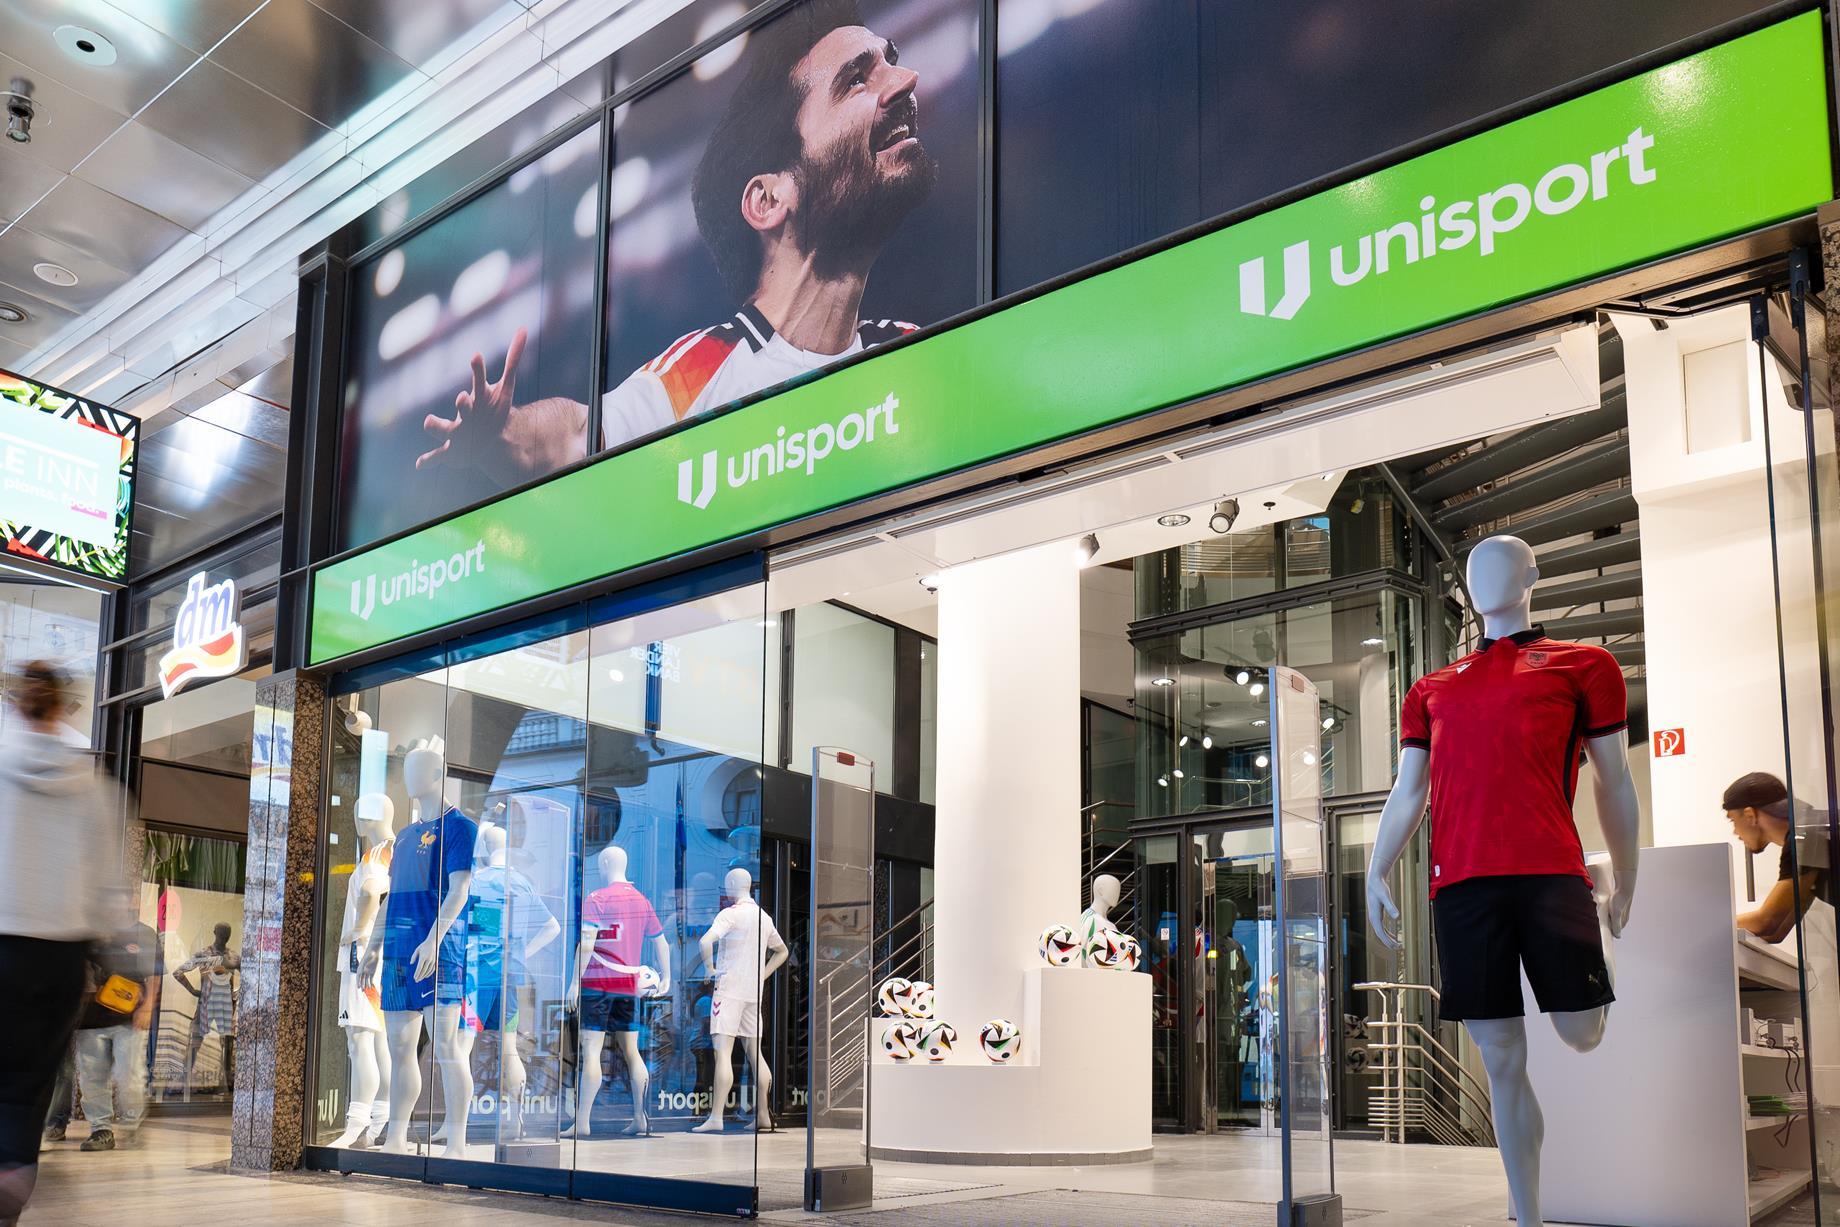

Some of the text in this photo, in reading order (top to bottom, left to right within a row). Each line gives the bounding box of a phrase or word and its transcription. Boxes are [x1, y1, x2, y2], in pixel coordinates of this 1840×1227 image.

[1330, 126, 1657, 286] unisport
[728, 391, 900, 488] unisport
[37, 455, 99, 497] INN
[381, 538, 485, 606] unisport
[177, 579, 232, 649] dm
